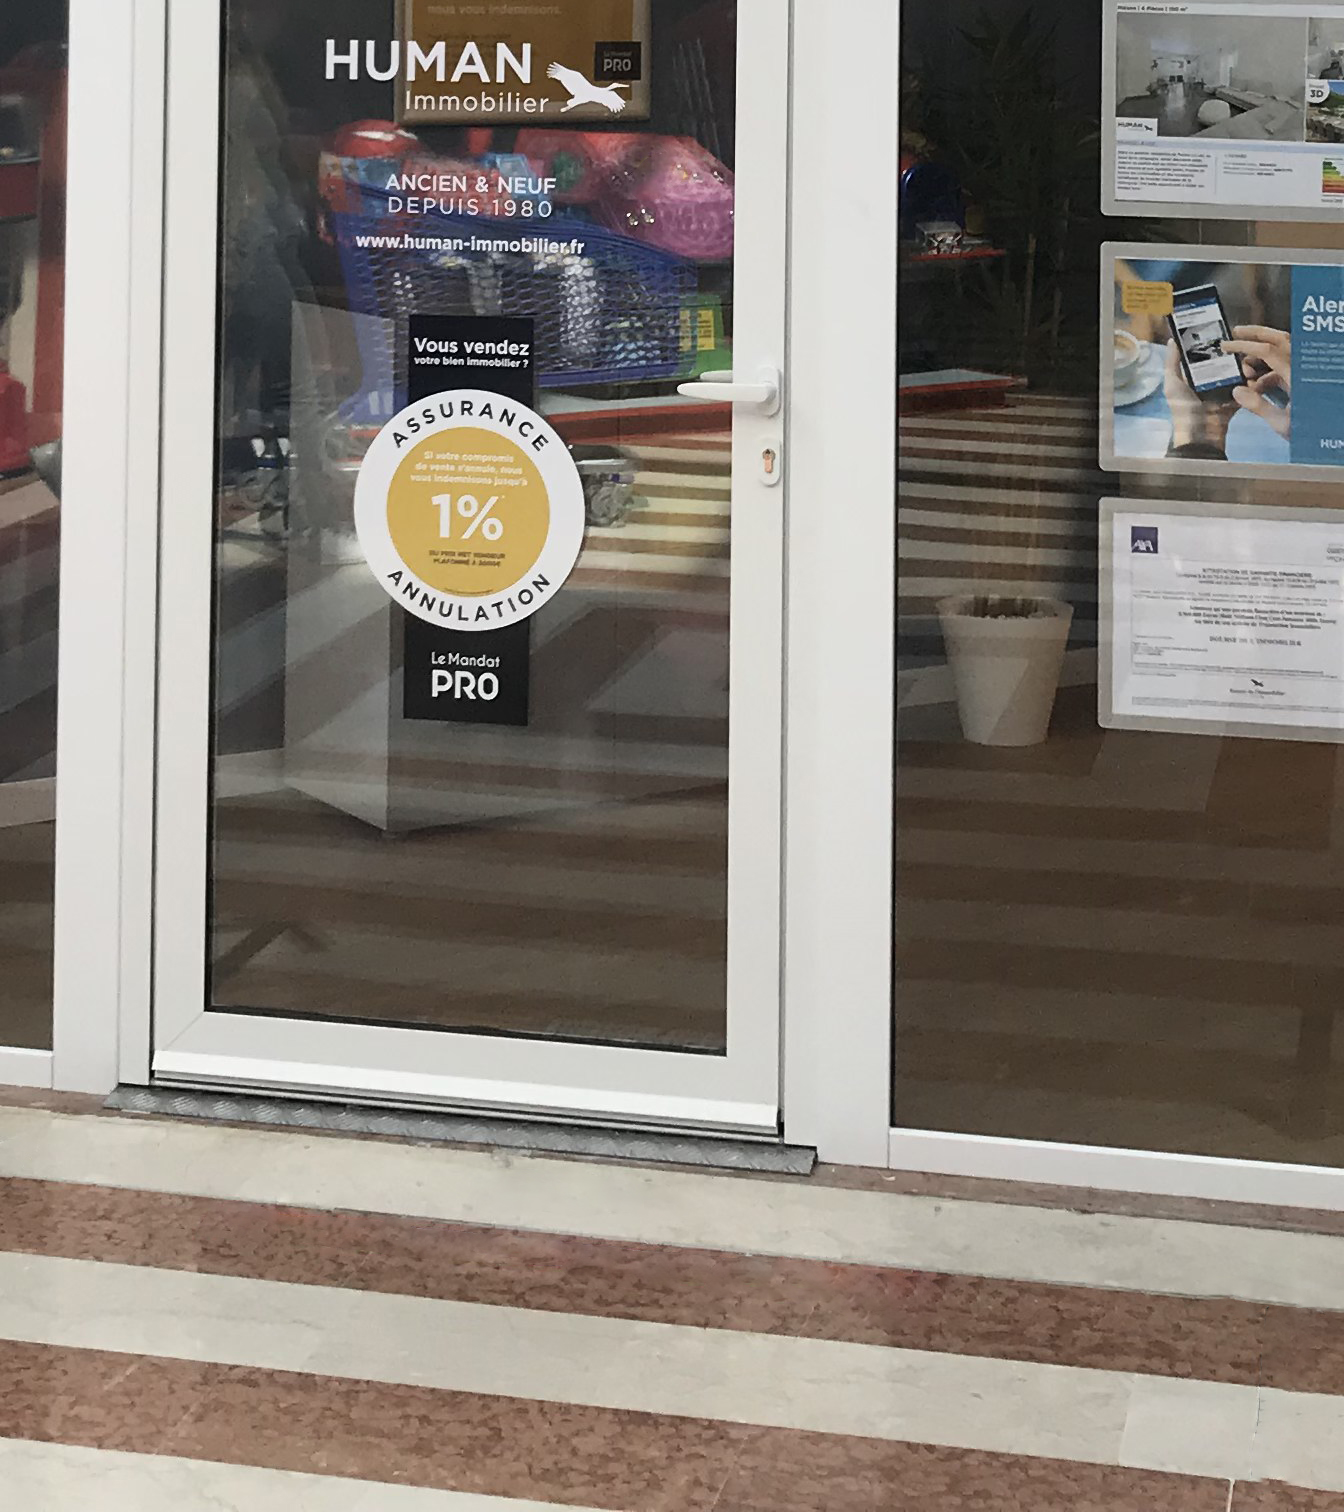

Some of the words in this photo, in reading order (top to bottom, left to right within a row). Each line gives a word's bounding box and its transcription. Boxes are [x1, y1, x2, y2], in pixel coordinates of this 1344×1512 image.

[325, 39, 532, 83] HUMAN
[603, 58, 632, 72] PRO
[405, 89, 550, 114] Immobilier
[1309, 90, 1324, 99] 3D
[385, 174, 468, 194] ANCIEN
[475, 176, 490, 194] &
[497, 176, 557, 196] NEUF
[387, 196, 480, 216] DEPUIS
[492, 198, 553, 218] 1980
[356, 232, 585, 257] www.human-immobilier.fr
[413, 337, 459, 353] Vous
[463, 339, 530, 356] vendez
[414, 356, 440, 365] votre
[442, 356, 464, 366] bien
[466, 357, 521, 368] immobilier
[392, 400, 549, 451] ASSURANCE
[436, 452, 460, 461] votre
[462, 453, 514, 463] compromis
[387, 573, 551, 622] ANNULATION
[431, 652, 449, 667] Le
[449, 652, 500, 669] Mandat
[430, 670, 500, 701] PRO
